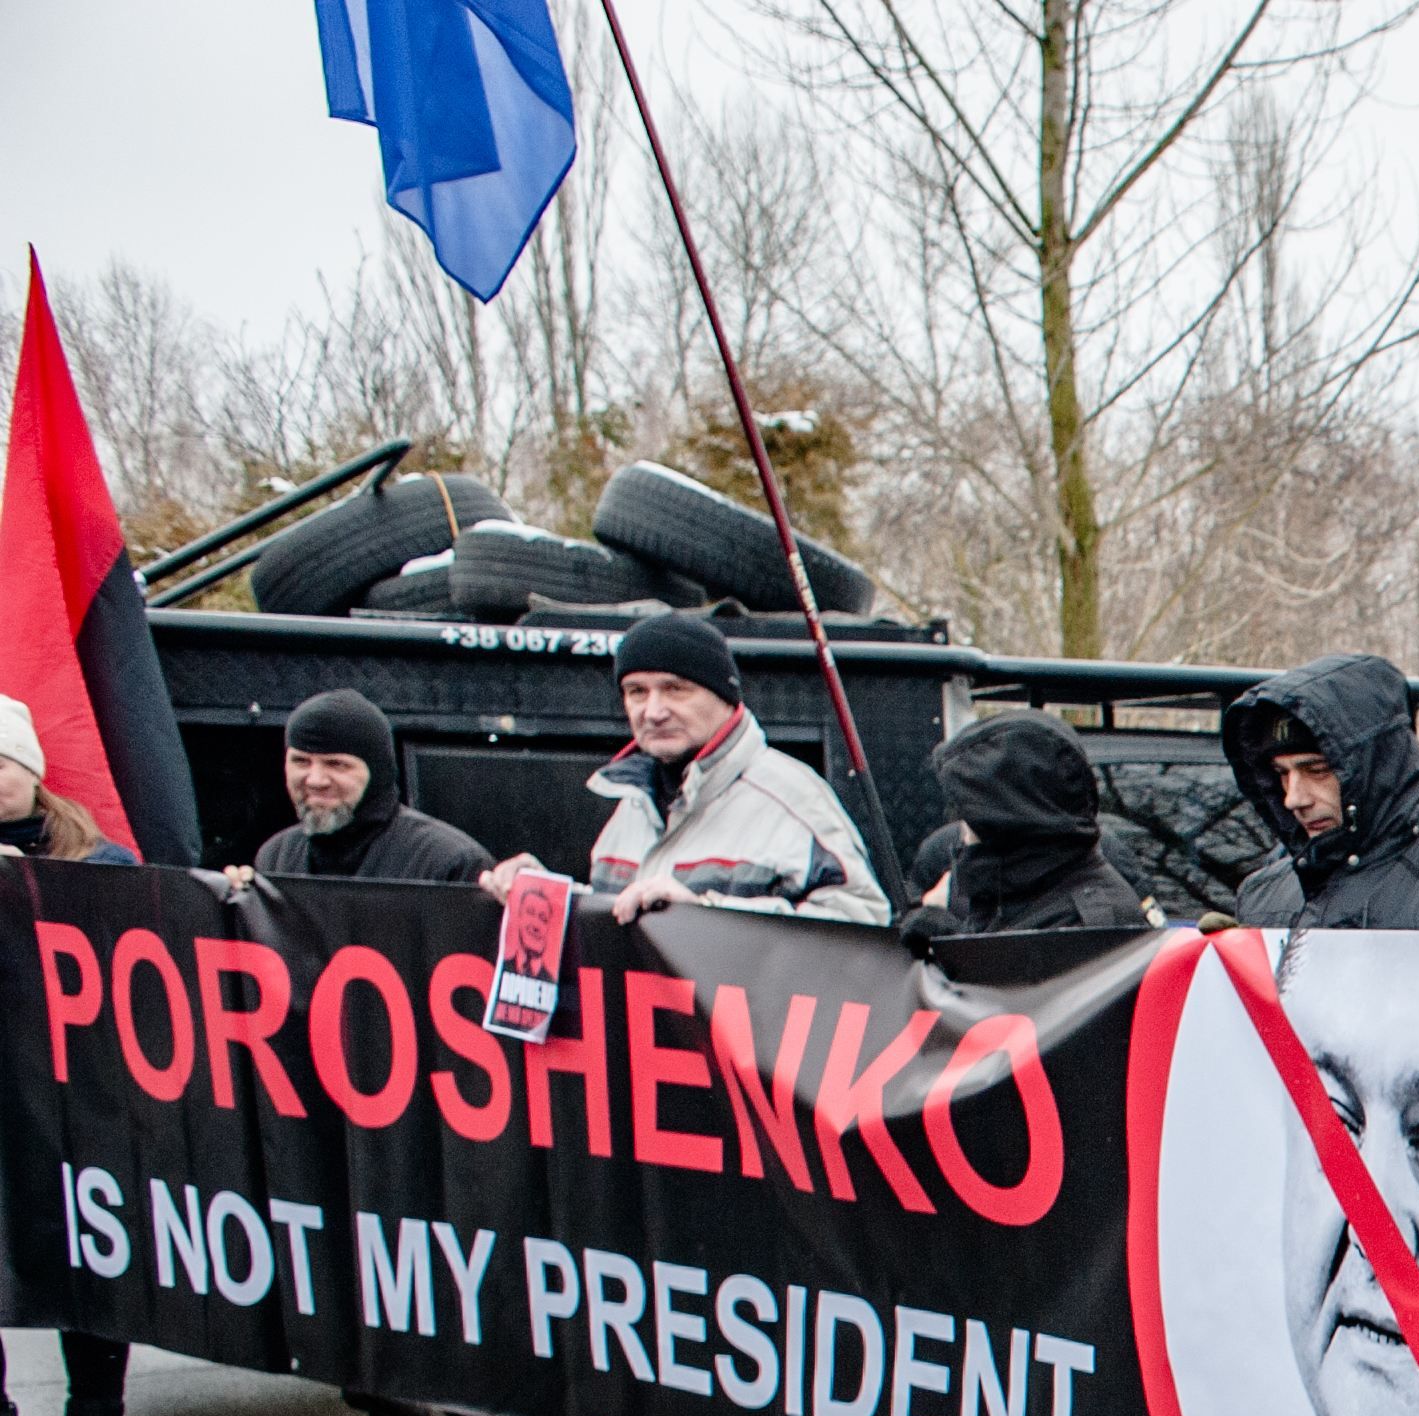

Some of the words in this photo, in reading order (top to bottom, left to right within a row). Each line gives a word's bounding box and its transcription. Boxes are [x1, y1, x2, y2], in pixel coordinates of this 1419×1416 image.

[440, 626, 500, 650] +38
[506, 628, 564, 654] 067
[33, 920, 1065, 1228] POROSHENKO
[62, 1161, 131, 1279] IS
[149, 1178, 323, 1316] NOT
[356, 1211, 496, 1346] MY
